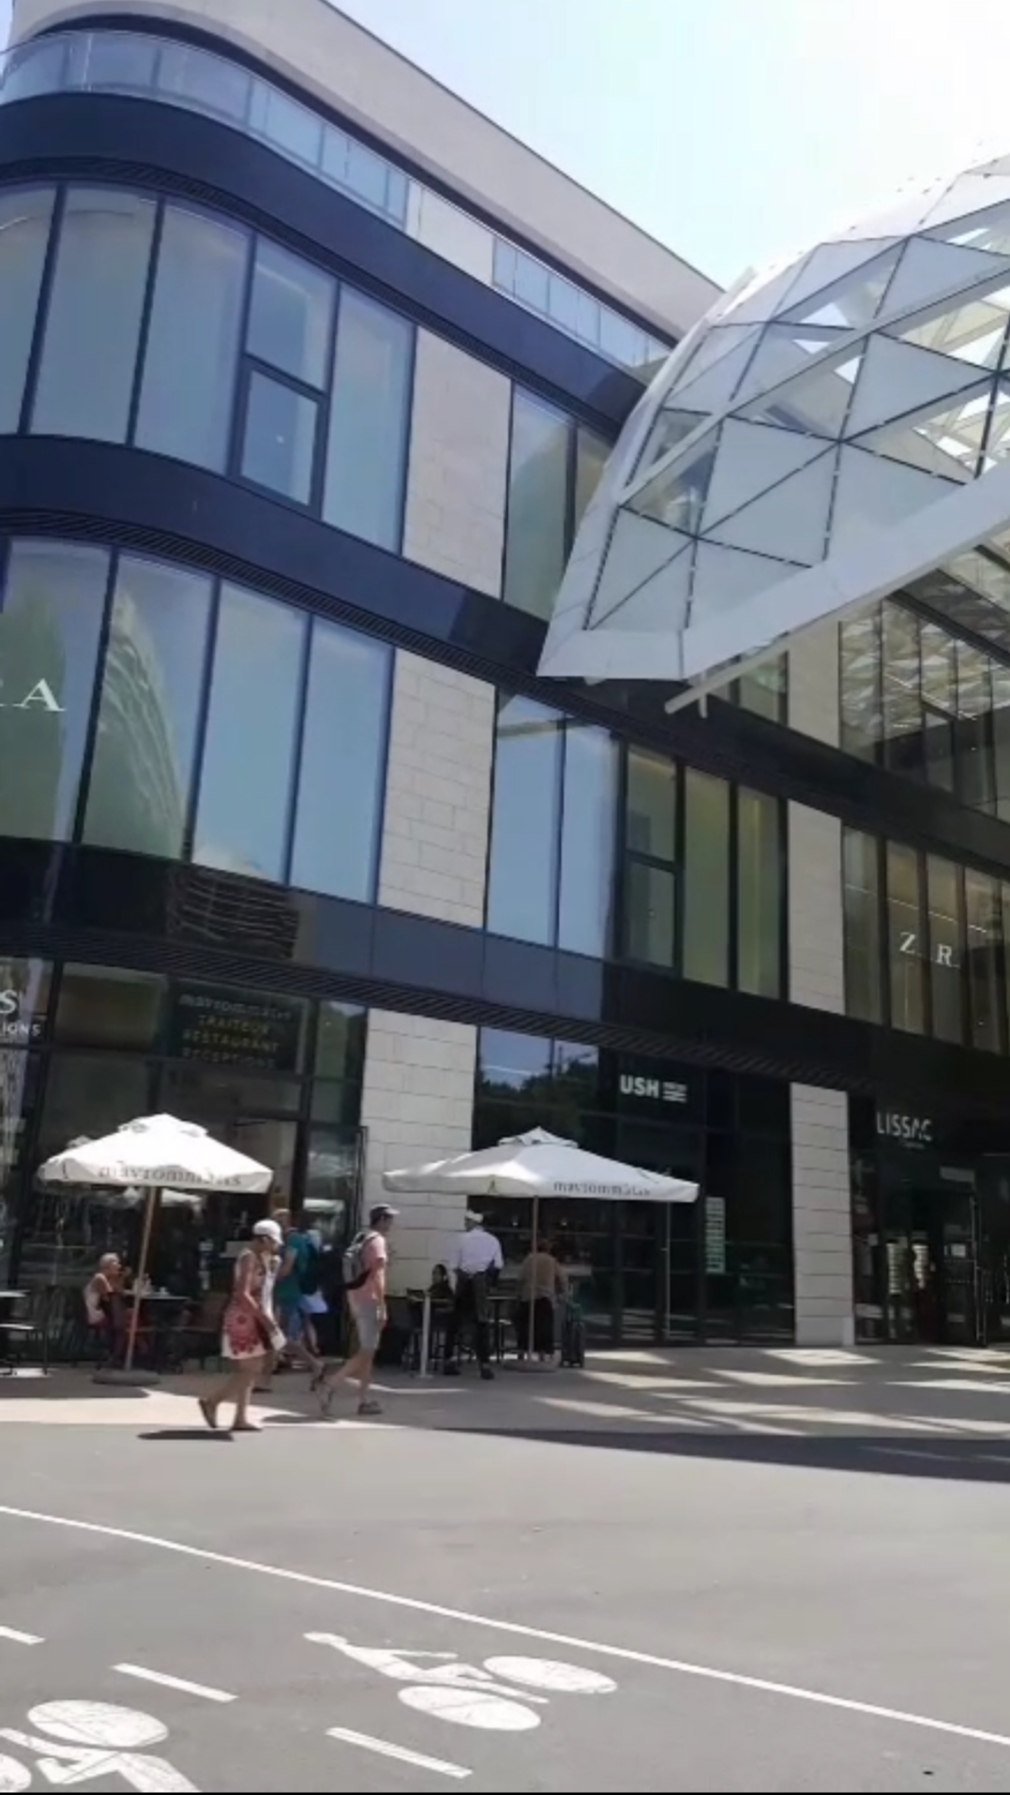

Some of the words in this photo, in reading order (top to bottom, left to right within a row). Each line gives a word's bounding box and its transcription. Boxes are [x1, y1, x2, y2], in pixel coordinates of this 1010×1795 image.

[181, 1028, 281, 1054] RESTAURANT
[620, 1074, 660, 1099] USH
[877, 1111, 932, 1142] LISSAC
